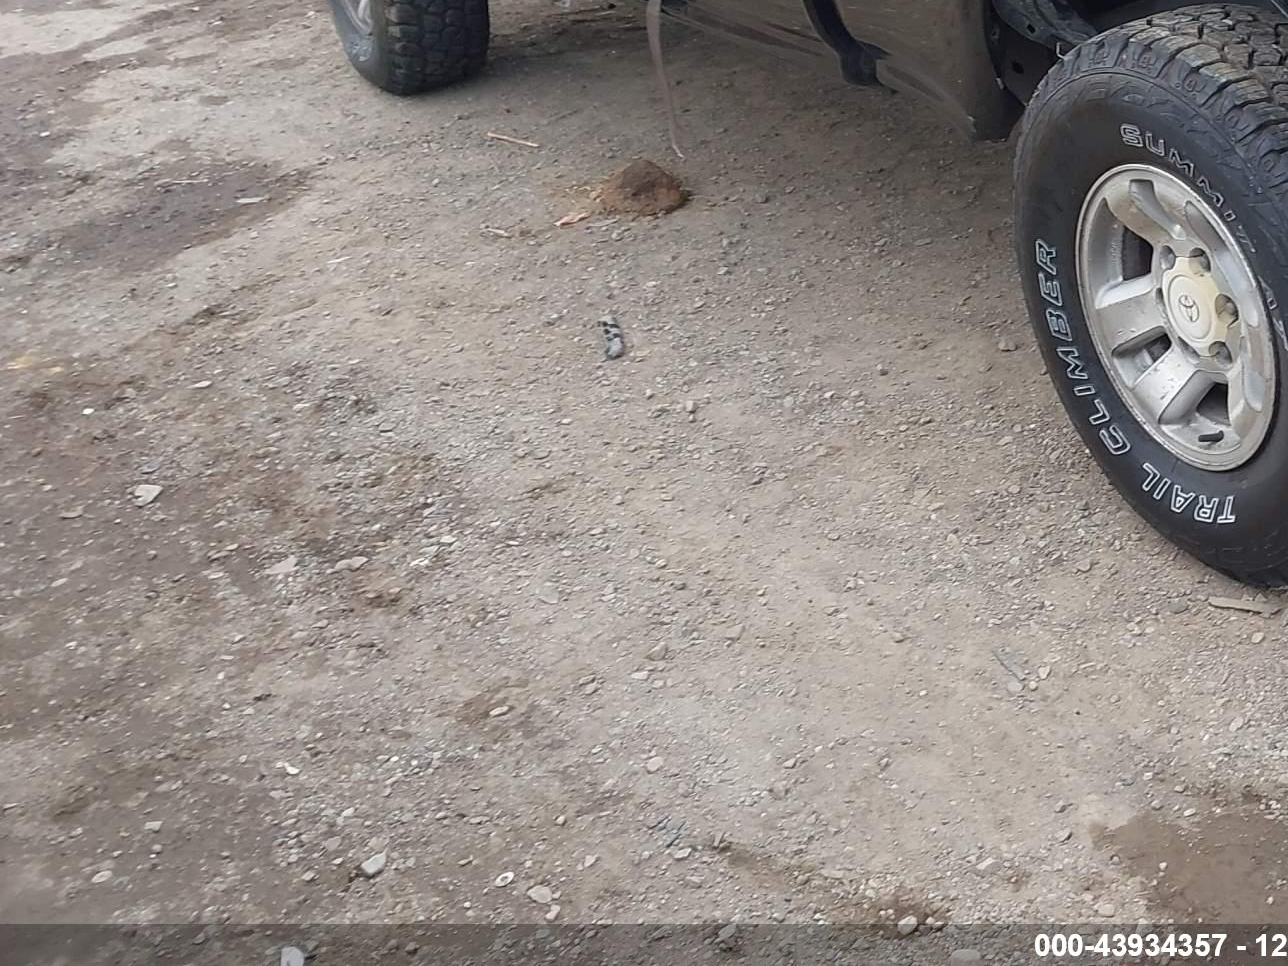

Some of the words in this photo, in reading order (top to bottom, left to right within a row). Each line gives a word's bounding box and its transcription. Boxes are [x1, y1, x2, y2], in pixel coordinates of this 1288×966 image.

[1120, 123, 1257, 253] SUMMIT
[1035, 238, 1131, 456] CLIMBER
[1141, 461, 1236, 524] TRAIL
